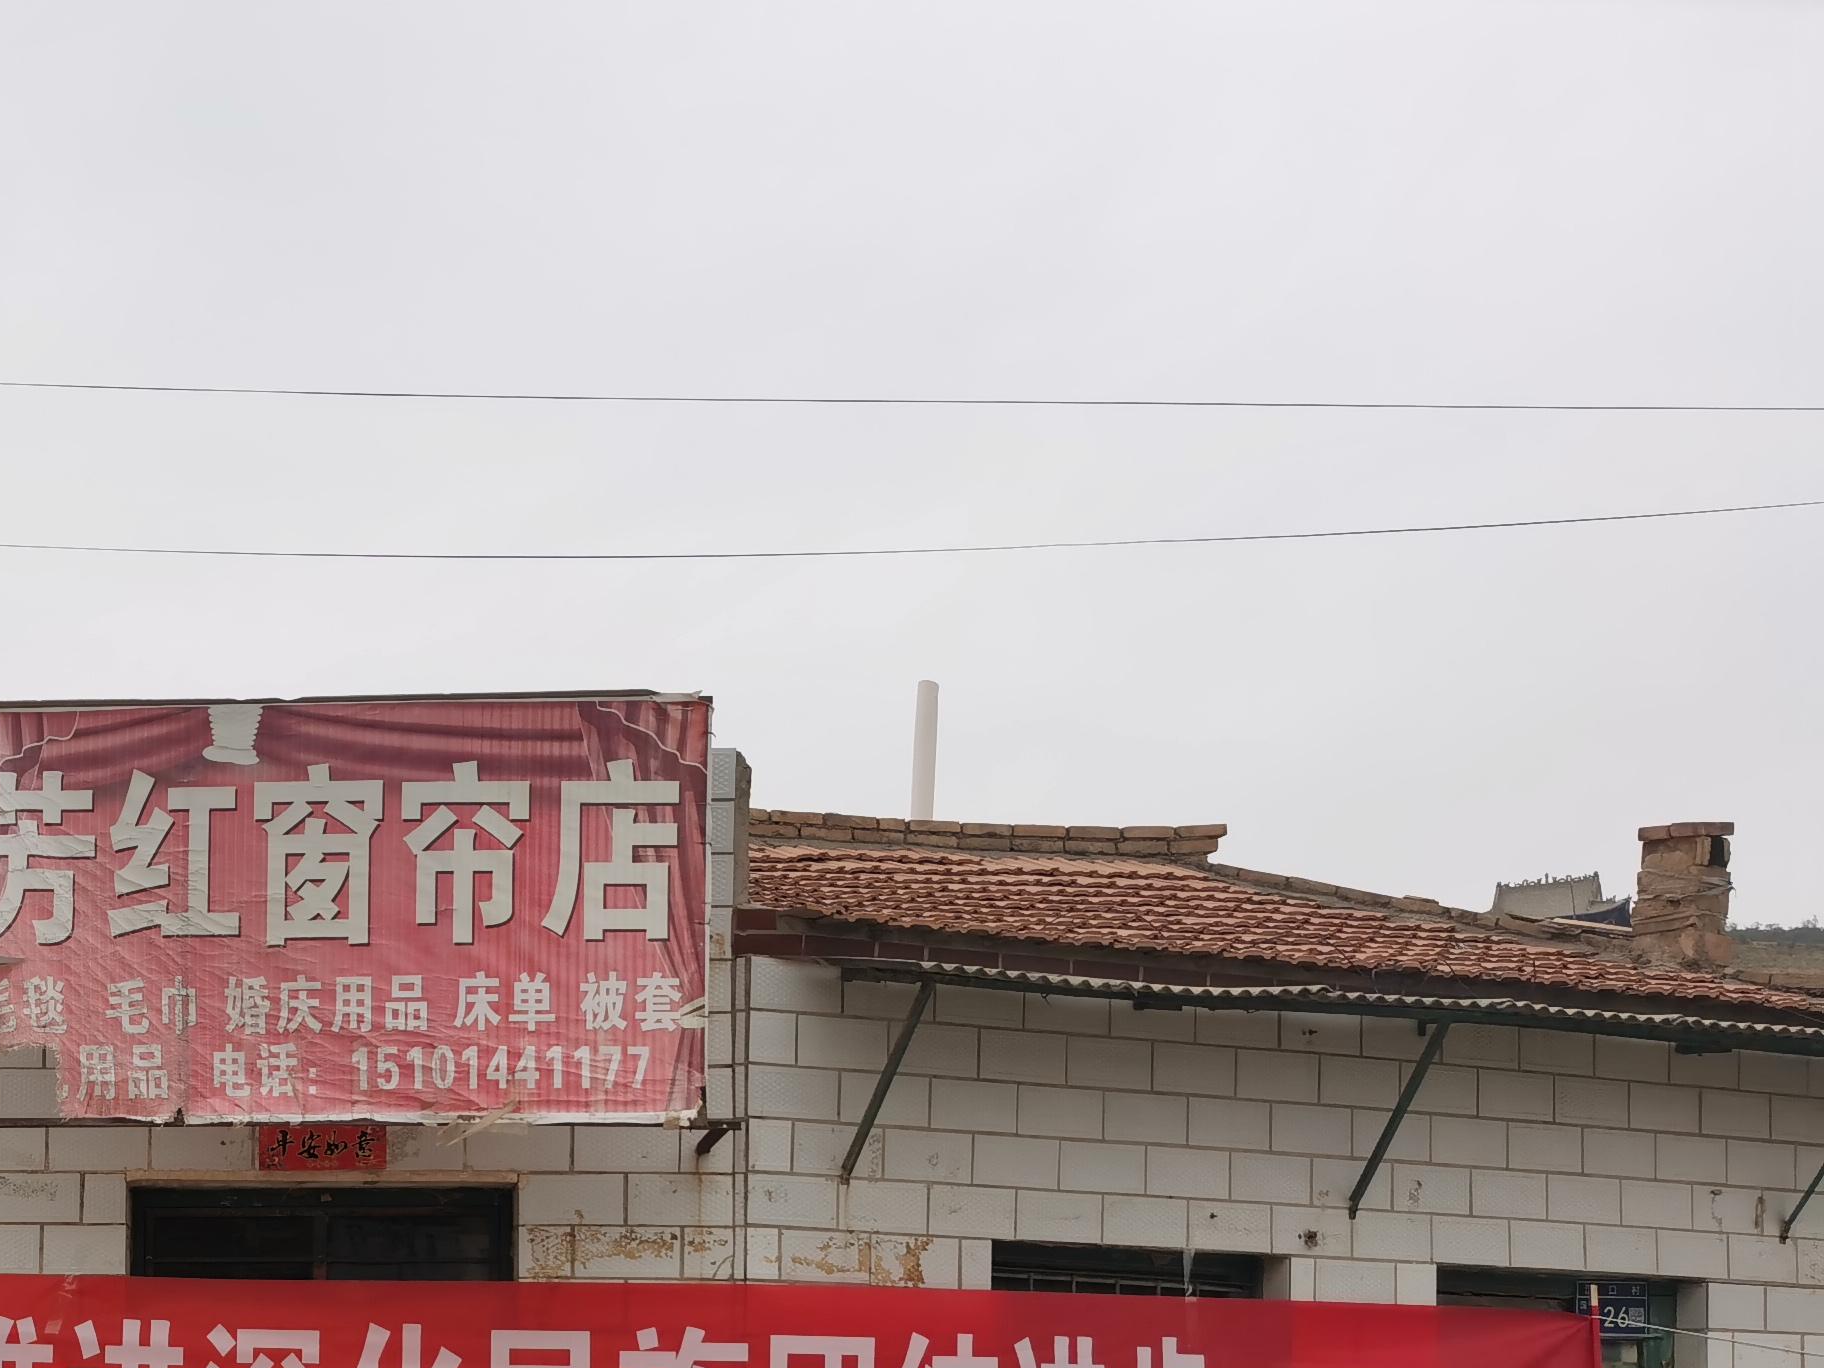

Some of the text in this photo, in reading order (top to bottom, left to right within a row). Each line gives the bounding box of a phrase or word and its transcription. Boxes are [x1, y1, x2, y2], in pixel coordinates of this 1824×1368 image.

[105, 976, 198, 1035] 毛巾
[224, 974, 428, 1035] 婚庆用品
[454, 972, 556, 1031] 床单
[580, 972, 684, 1033] 被套
[56, 1044, 169, 1101] 用品
[1603, 1307, 1629, 1327] 26
